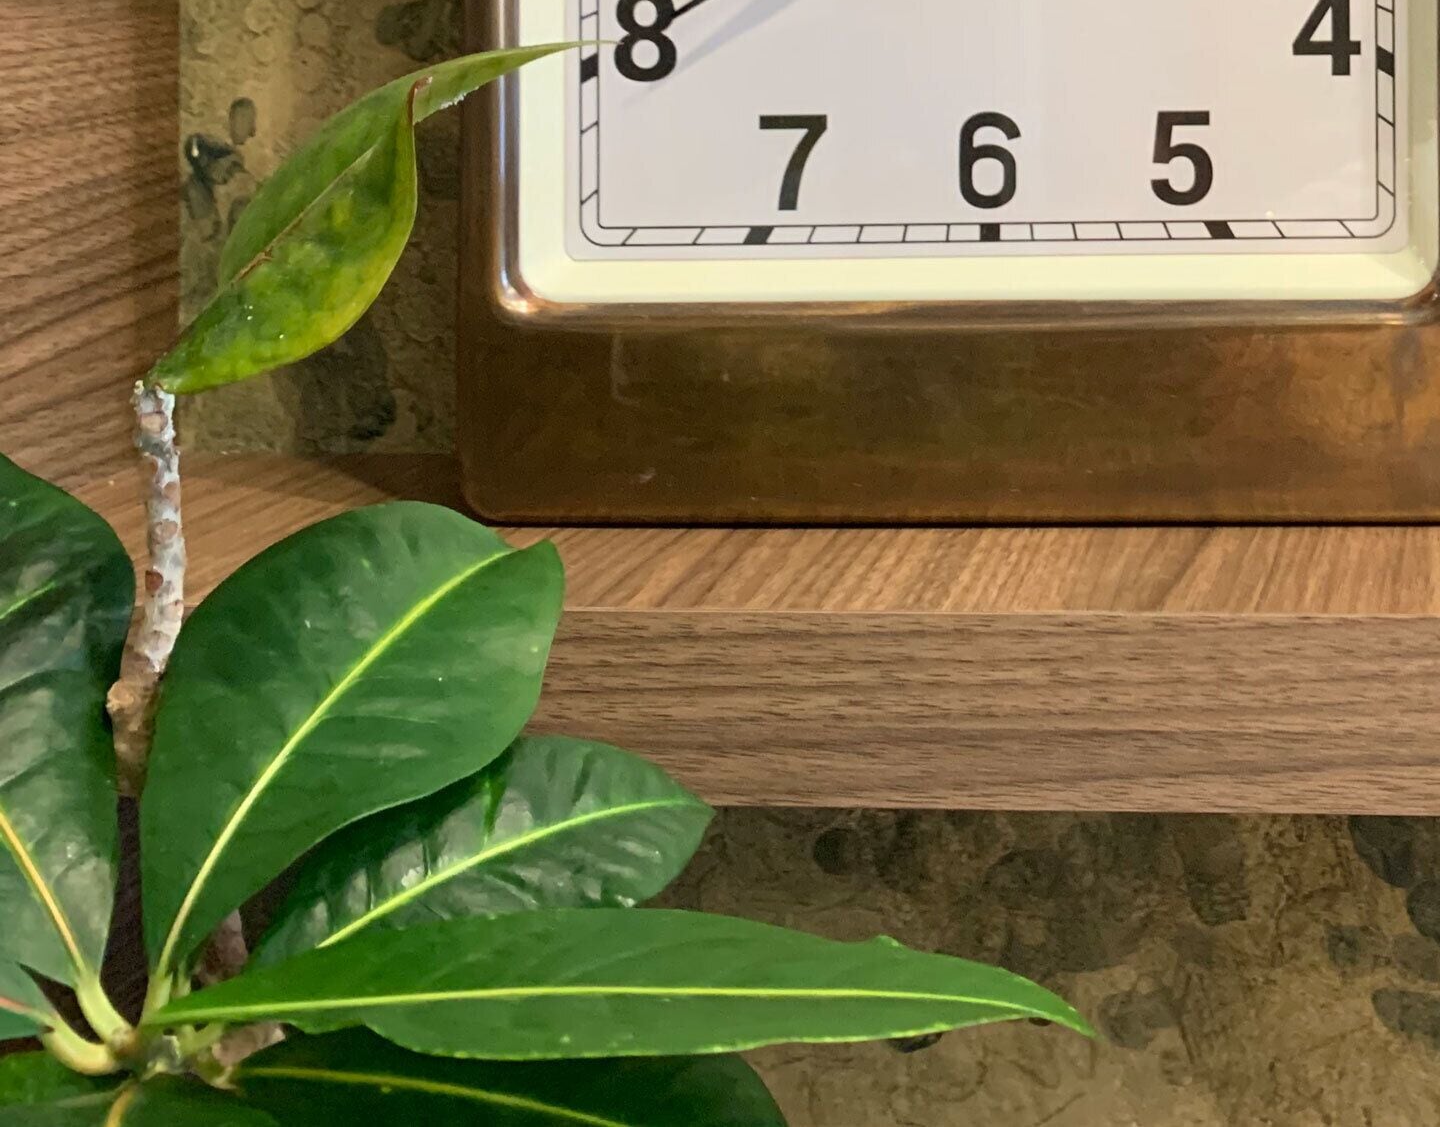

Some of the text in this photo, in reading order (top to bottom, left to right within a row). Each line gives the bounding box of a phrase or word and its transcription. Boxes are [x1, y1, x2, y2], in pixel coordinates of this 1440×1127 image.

[759, 114, 828, 210] 7
[959, 111, 1021, 209] 6
[1150, 110, 1214, 206] 5
